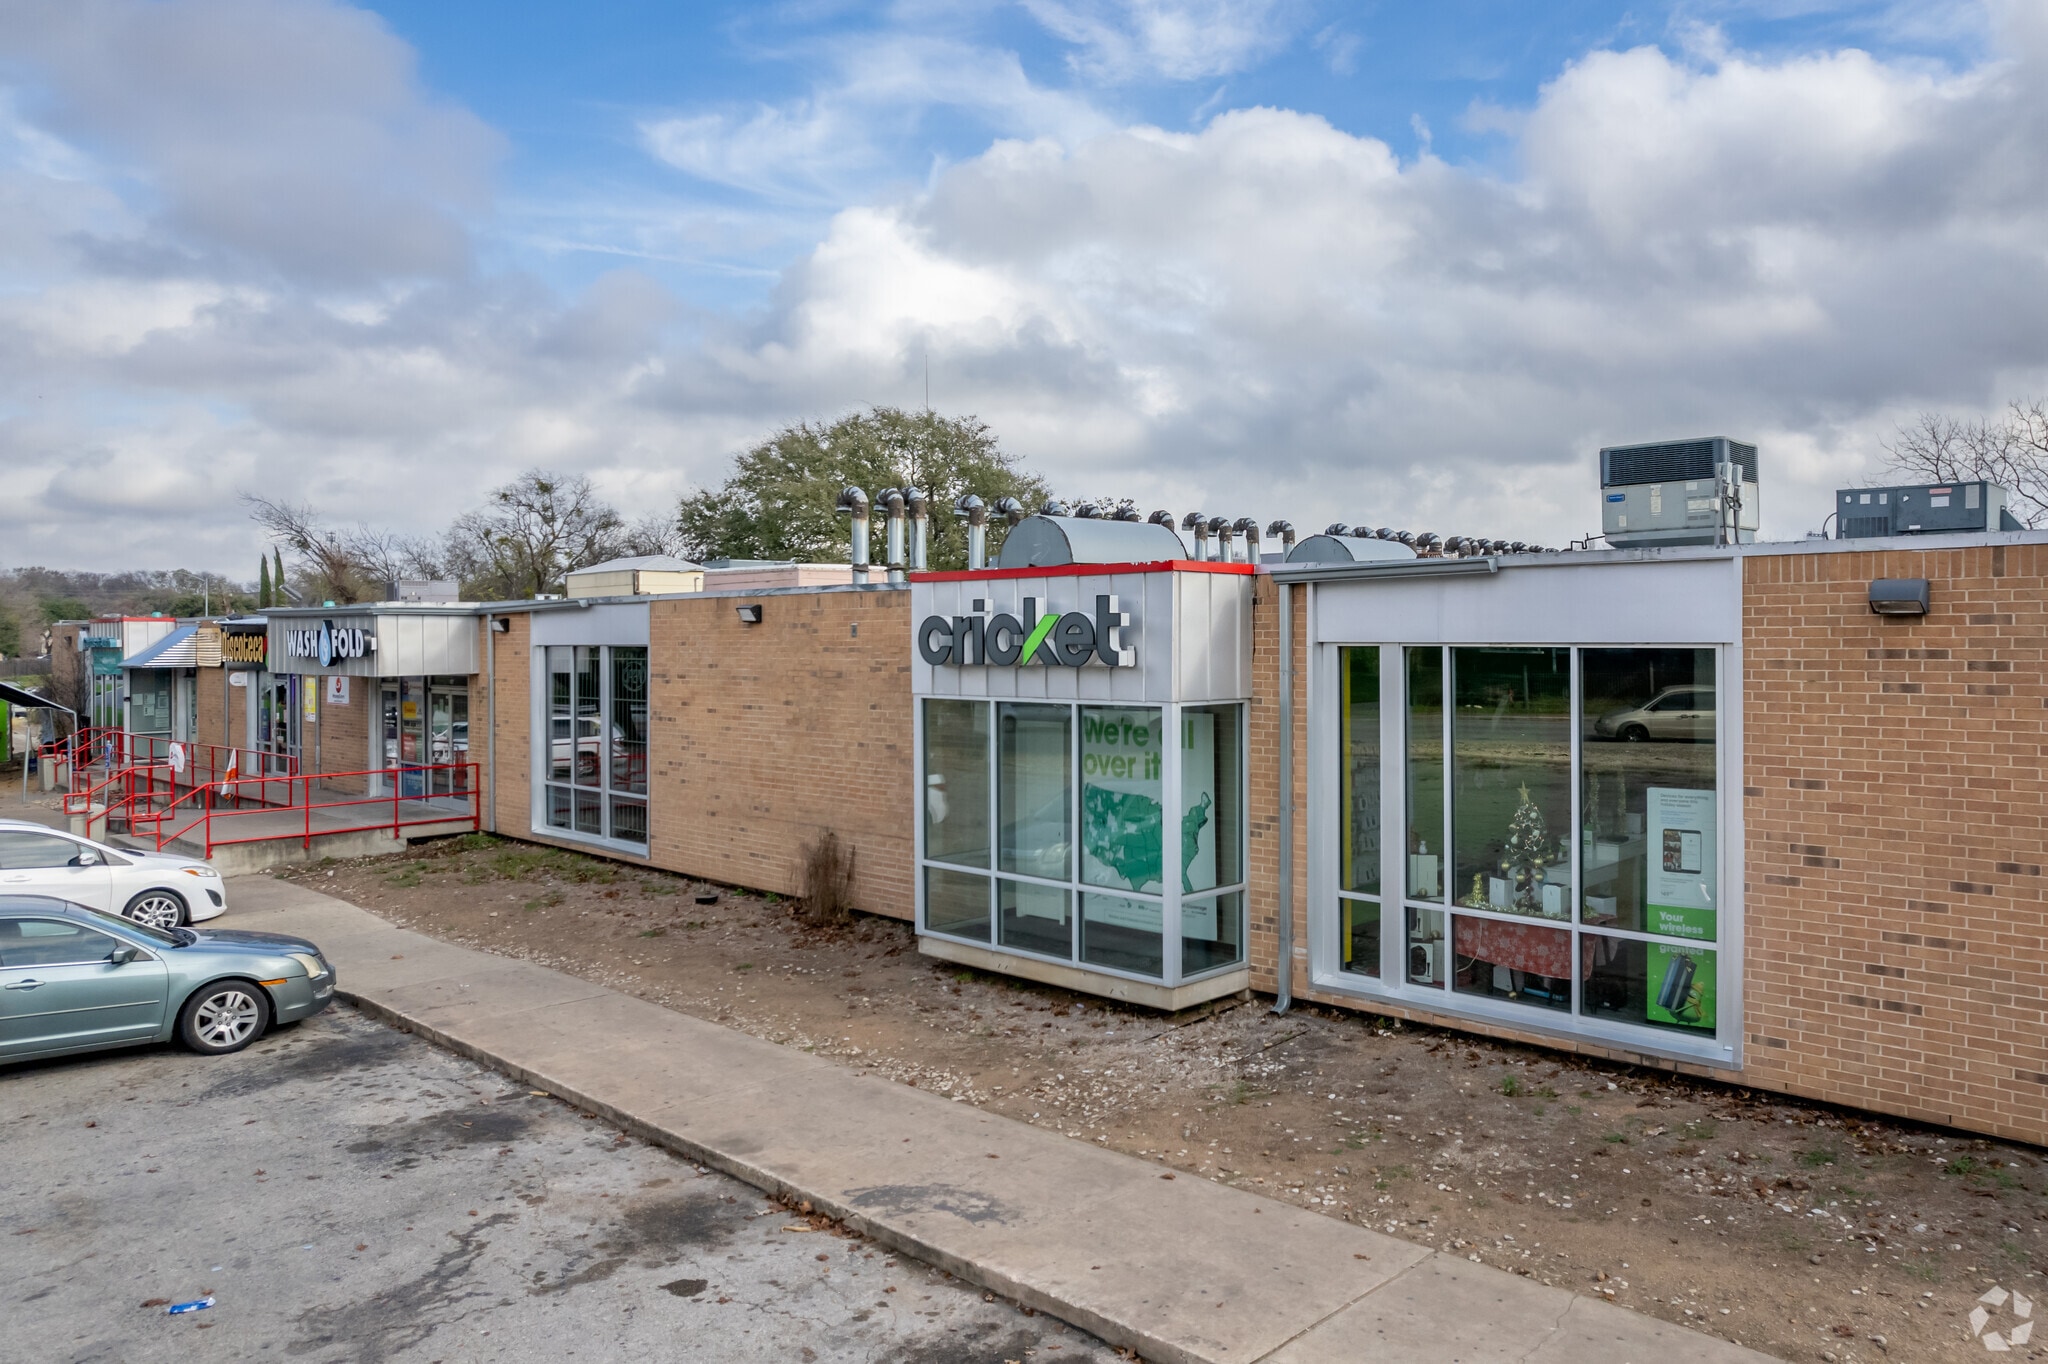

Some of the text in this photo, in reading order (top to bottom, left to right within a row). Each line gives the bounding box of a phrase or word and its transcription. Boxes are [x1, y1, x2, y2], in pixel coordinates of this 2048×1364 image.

[287, 630, 318, 657] WASH
[331, 628, 364, 658] FOLD
[918, 595, 1134, 667] cricket
[222, 631, 264, 663] Discoteca
[1083, 715, 1149, 747] We're
[1084, 752, 1161, 780] over it
[1660, 911, 1684, 922] Your
[1660, 922, 1703, 935] wireless
